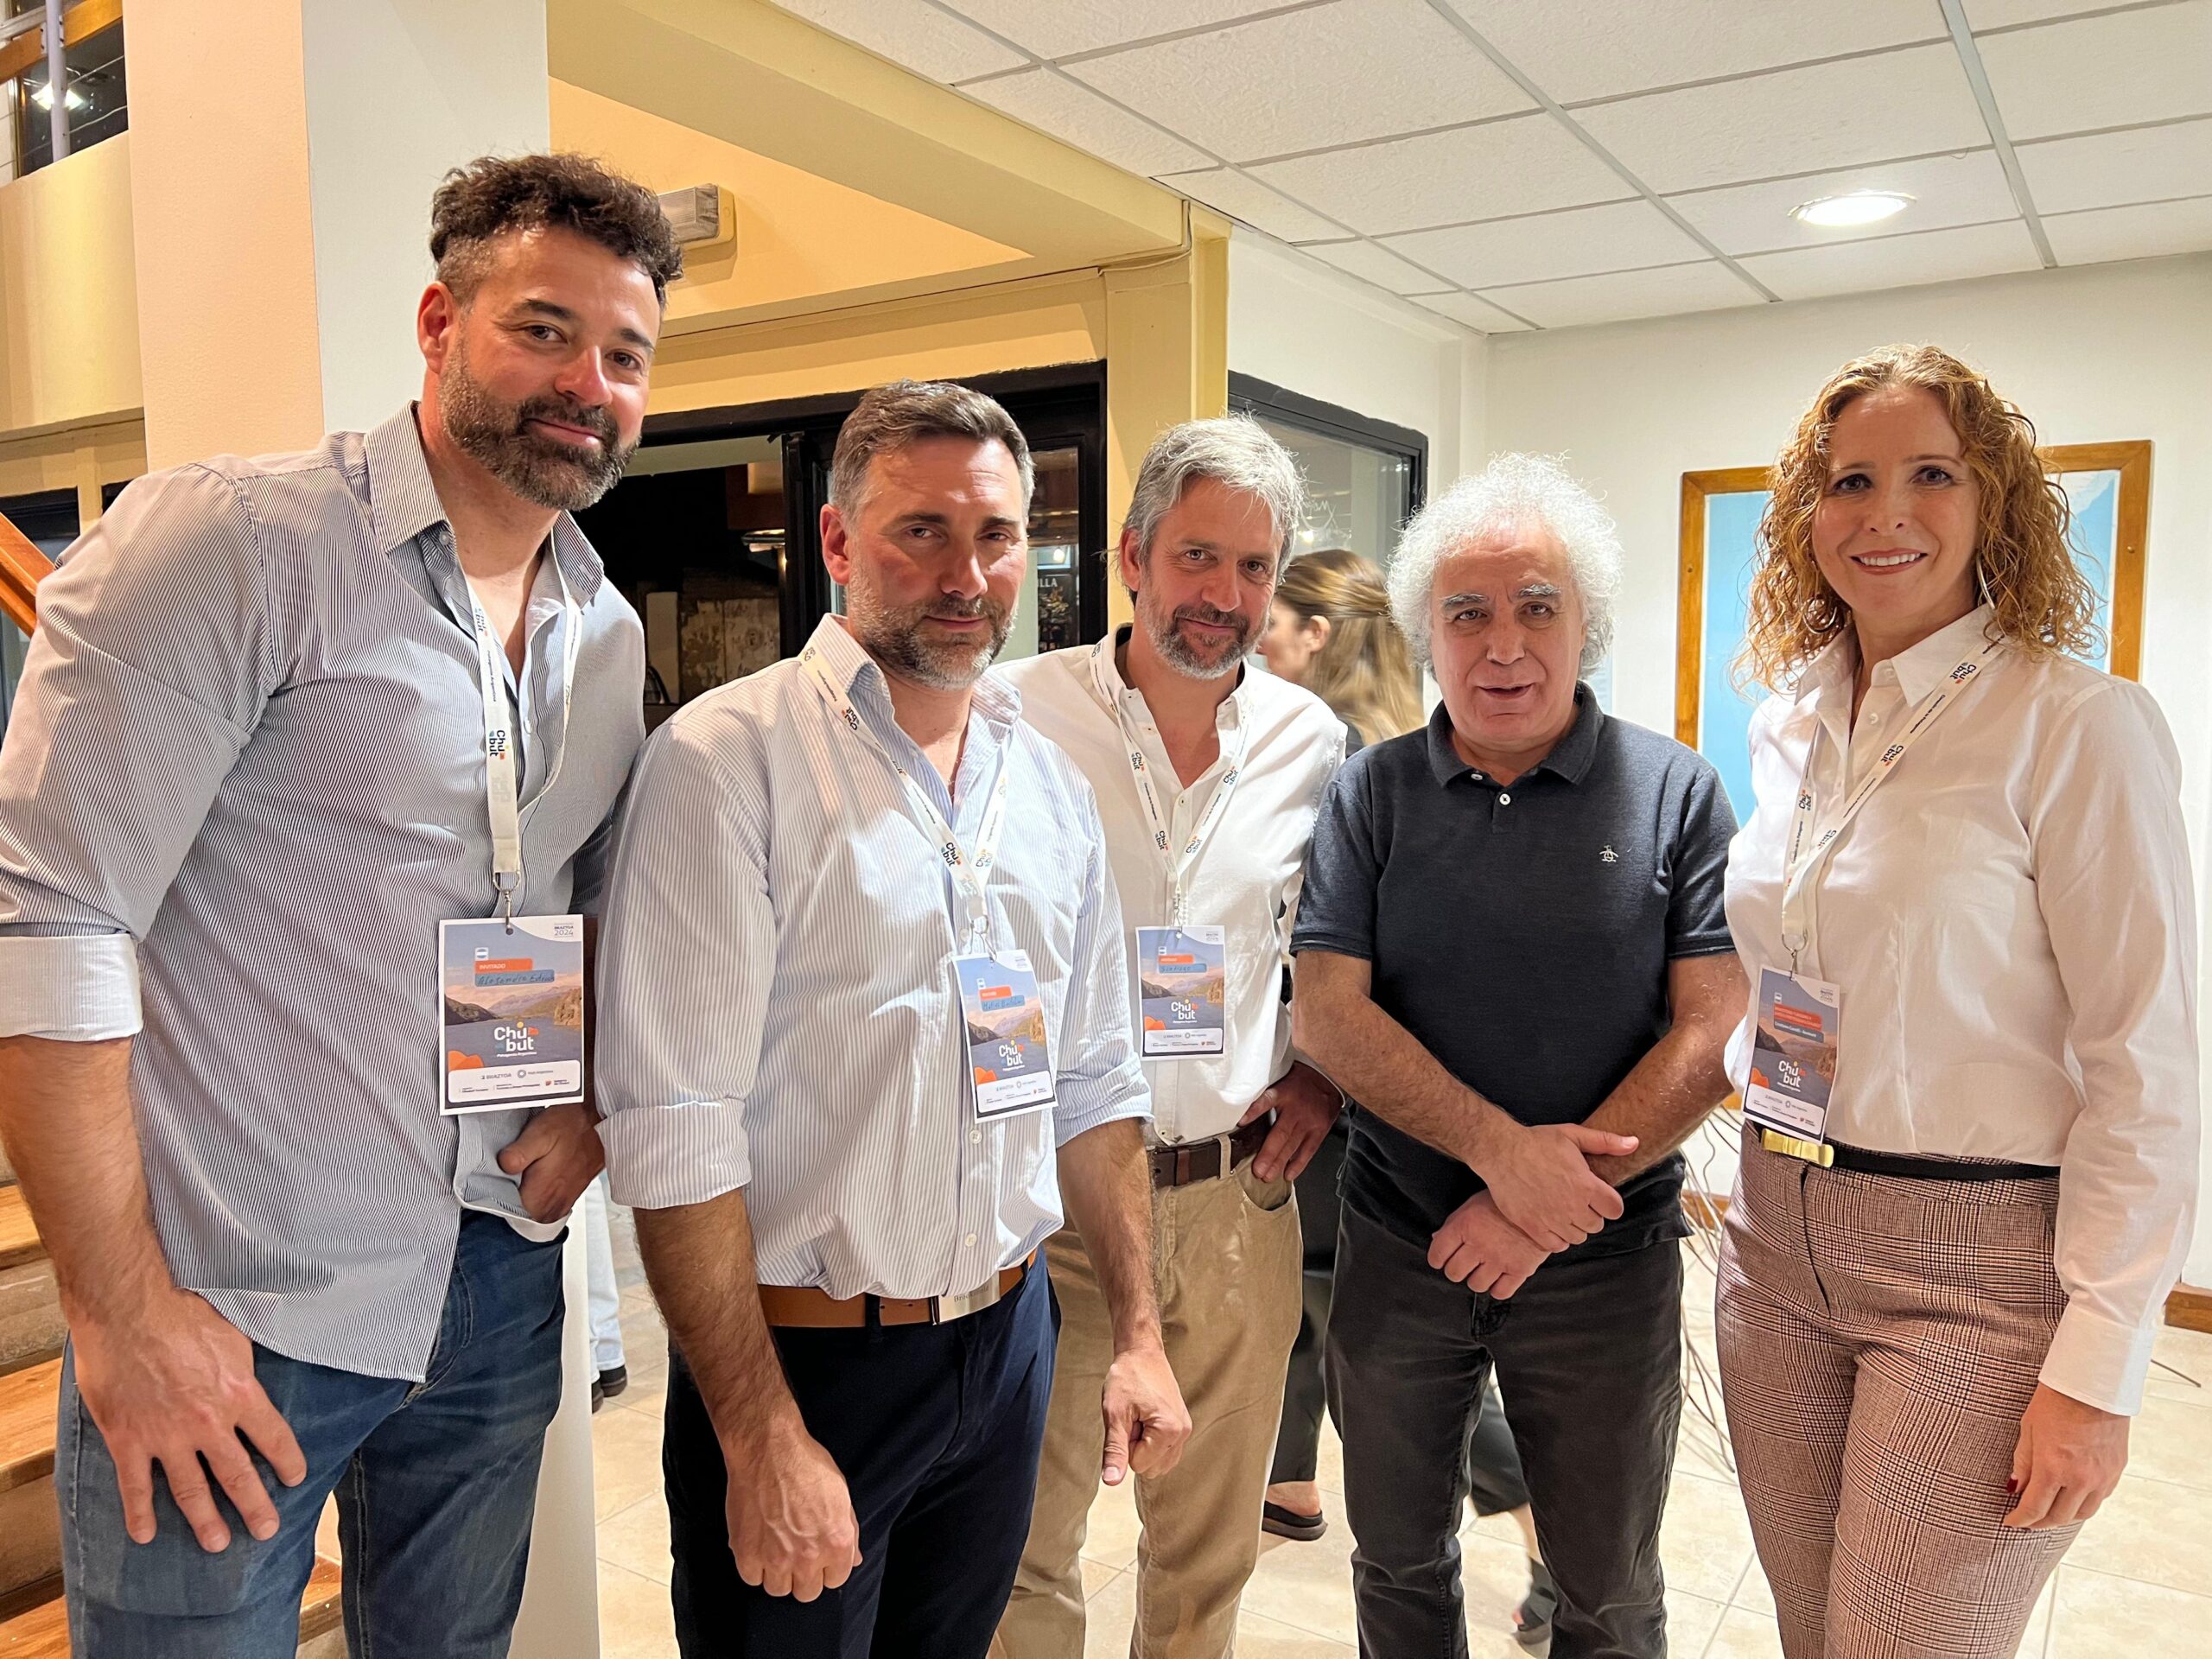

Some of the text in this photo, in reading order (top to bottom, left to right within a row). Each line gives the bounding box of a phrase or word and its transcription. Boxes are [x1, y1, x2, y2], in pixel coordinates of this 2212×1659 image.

[1949, 665, 1967, 680] but
[1959, 664, 1977, 680] Chu
[846, 706, 858, 722] but
[844, 714, 858, 731] Chu
[489, 738, 499, 757] but
[496, 730, 506, 752] Chu
[1135, 752, 1144, 766] Chu
[1880, 748, 1896, 763] but
[1888, 745, 1904, 761] Chu
[1132, 757, 1141, 771] but
[1224, 770, 1234, 784] Chu
[1230, 770, 1238, 782] but
[1156, 837, 1165, 850] but
[943, 850, 955, 868] but
[946, 842, 959, 861] Chu
[1178, 1009, 1196, 1020] but
[505, 1037, 534, 1052] but
[1007, 1052, 1024, 1067] but
[1783, 1071, 1802, 1088] but
